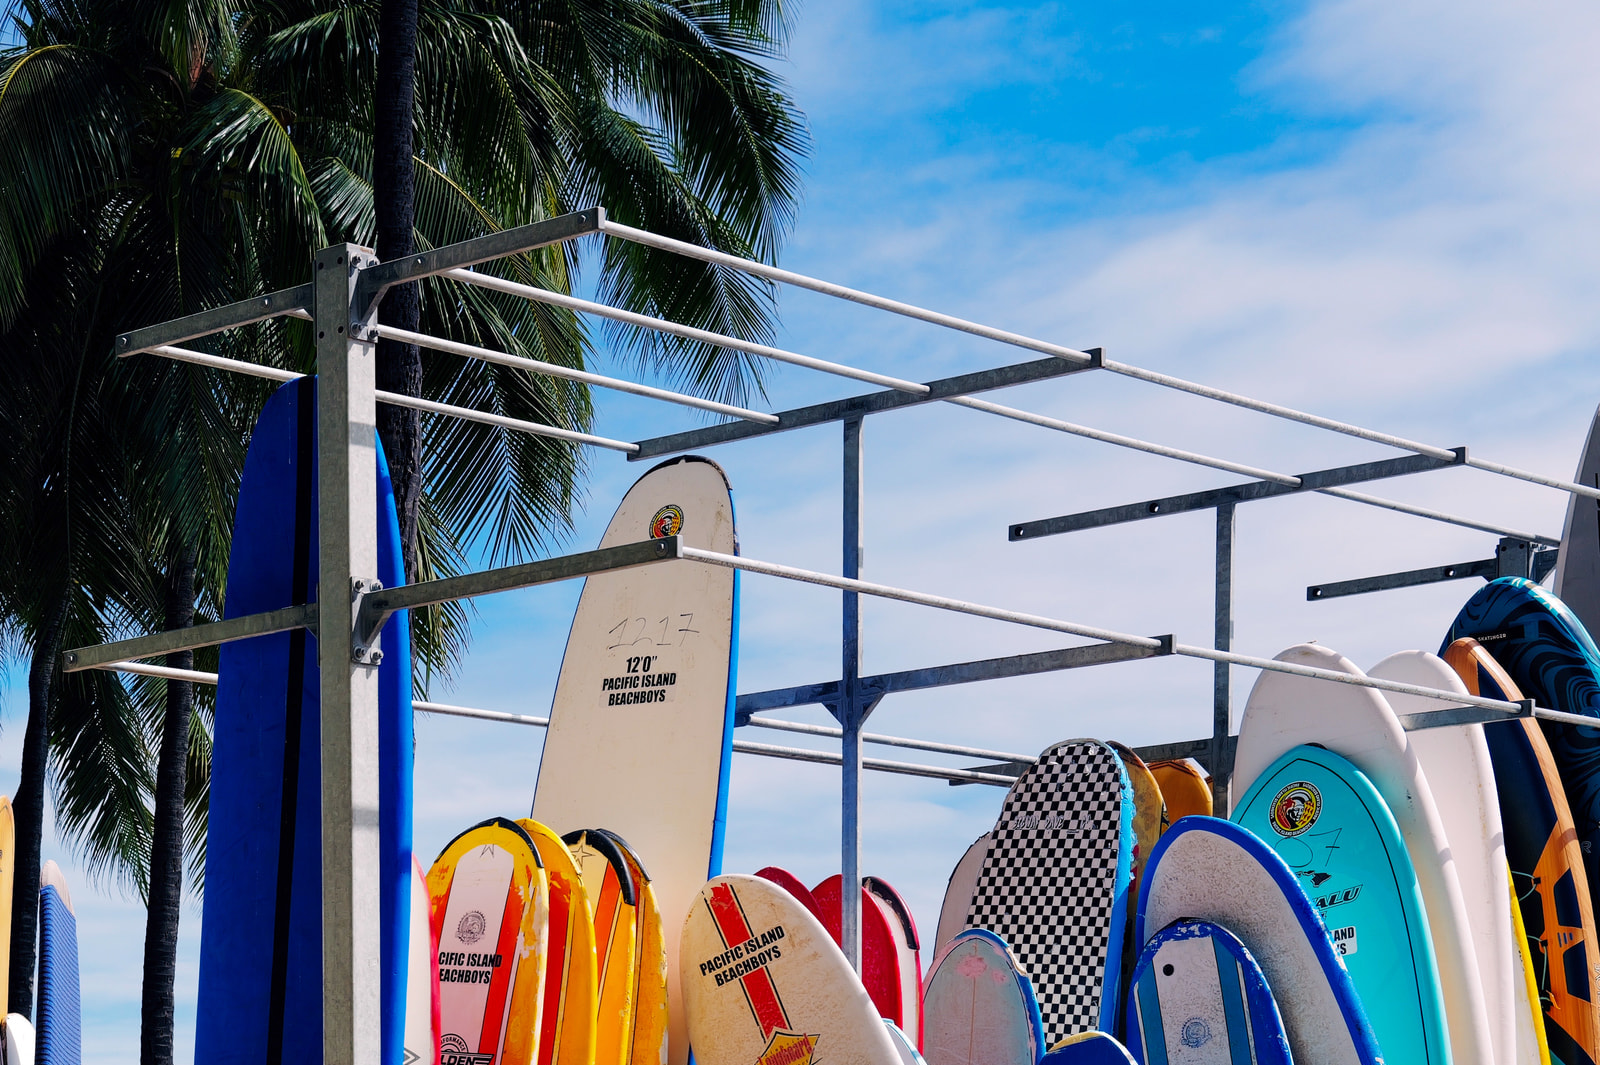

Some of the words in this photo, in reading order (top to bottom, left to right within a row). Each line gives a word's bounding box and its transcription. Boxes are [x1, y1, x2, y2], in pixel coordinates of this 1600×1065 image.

[609, 613, 700, 650] 1217
[602, 676, 640, 691] PACIFIC
[641, 672, 677, 688] ISLAND
[608, 689, 666, 706] BEACHBOYS
[466, 952, 503, 968] ISLAND
[699, 945, 744, 977] PACIFIC
[744, 925, 785, 955] ISLAND
[714, 945, 782, 987] BEACHBOYS
